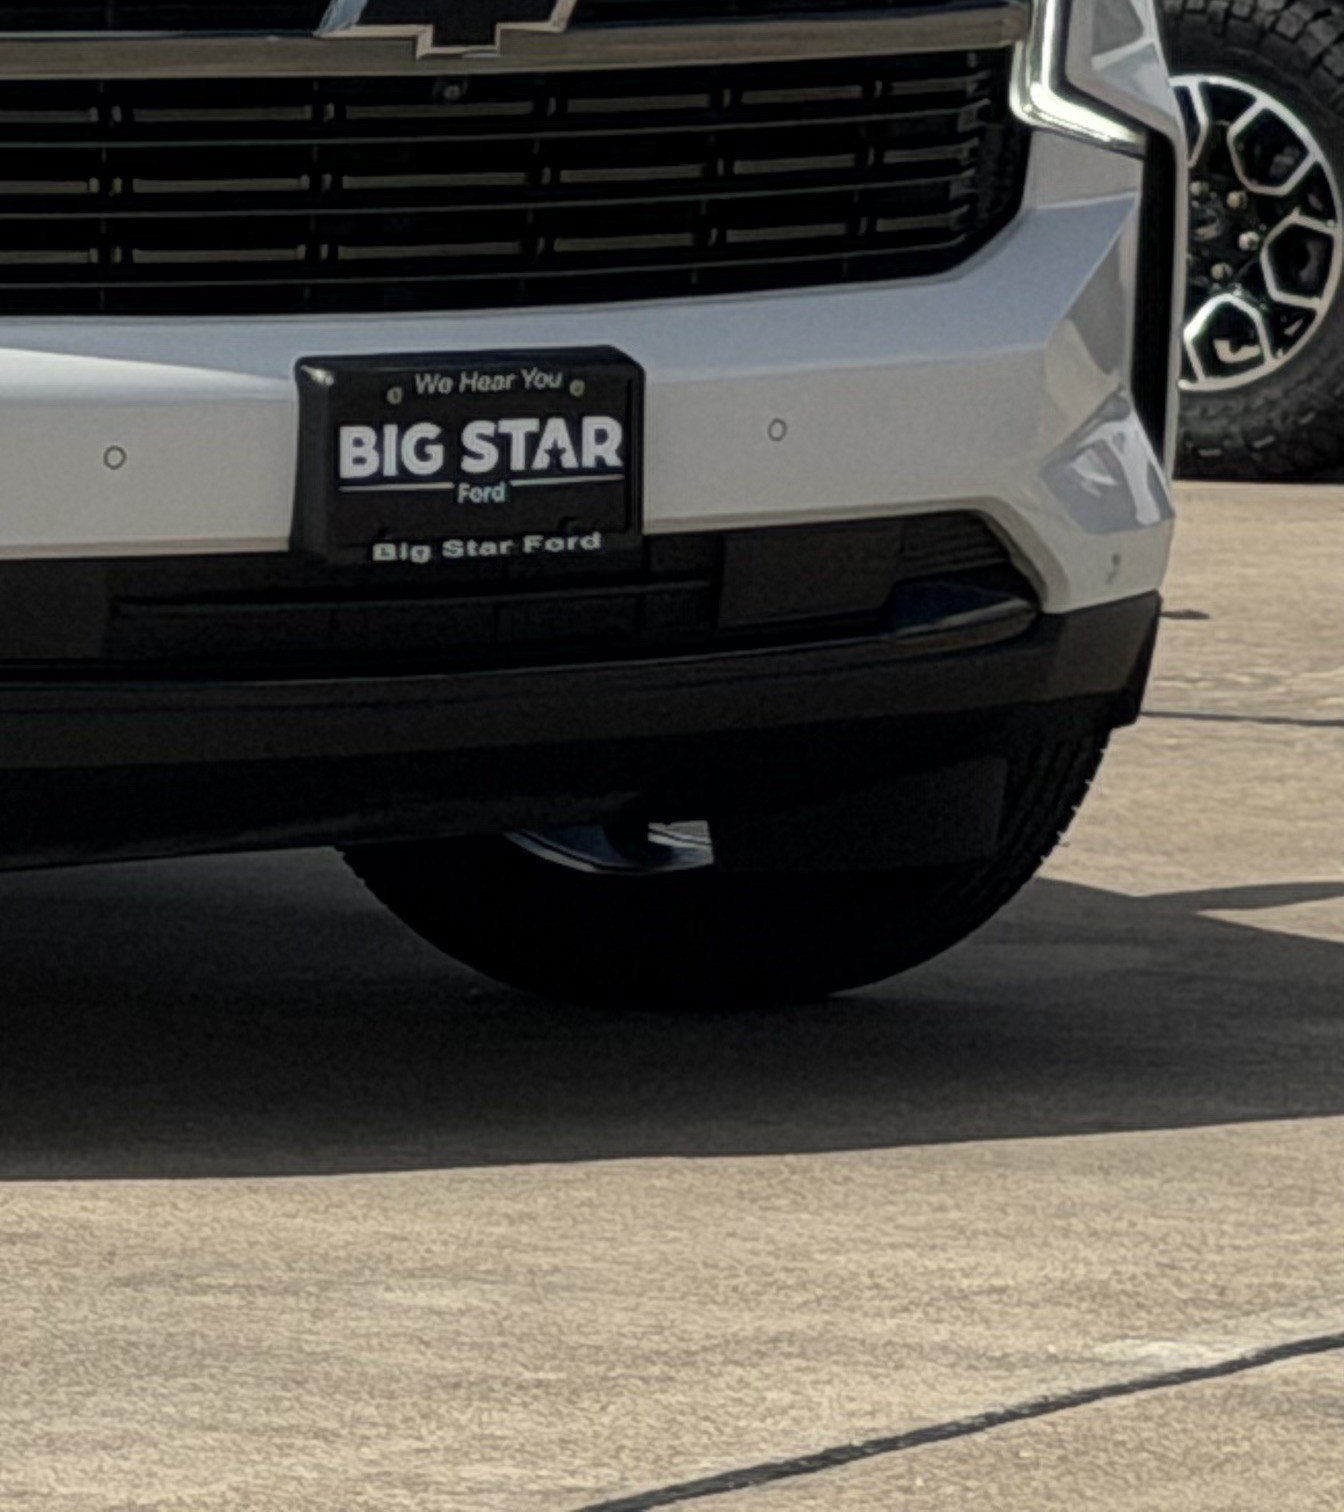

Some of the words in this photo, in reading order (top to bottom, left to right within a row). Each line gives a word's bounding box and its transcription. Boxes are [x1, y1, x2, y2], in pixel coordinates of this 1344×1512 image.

[415, 373, 453, 395] We
[459, 370, 516, 393] Hear
[520, 366, 563, 390] You
[339, 422, 445, 479] BIG
[460, 416, 624, 474] STAR
[457, 483, 507, 504] Ford
[372, 541, 432, 564] Big
[442, 538, 514, 559] Star
[522, 531, 602, 554] Ford
